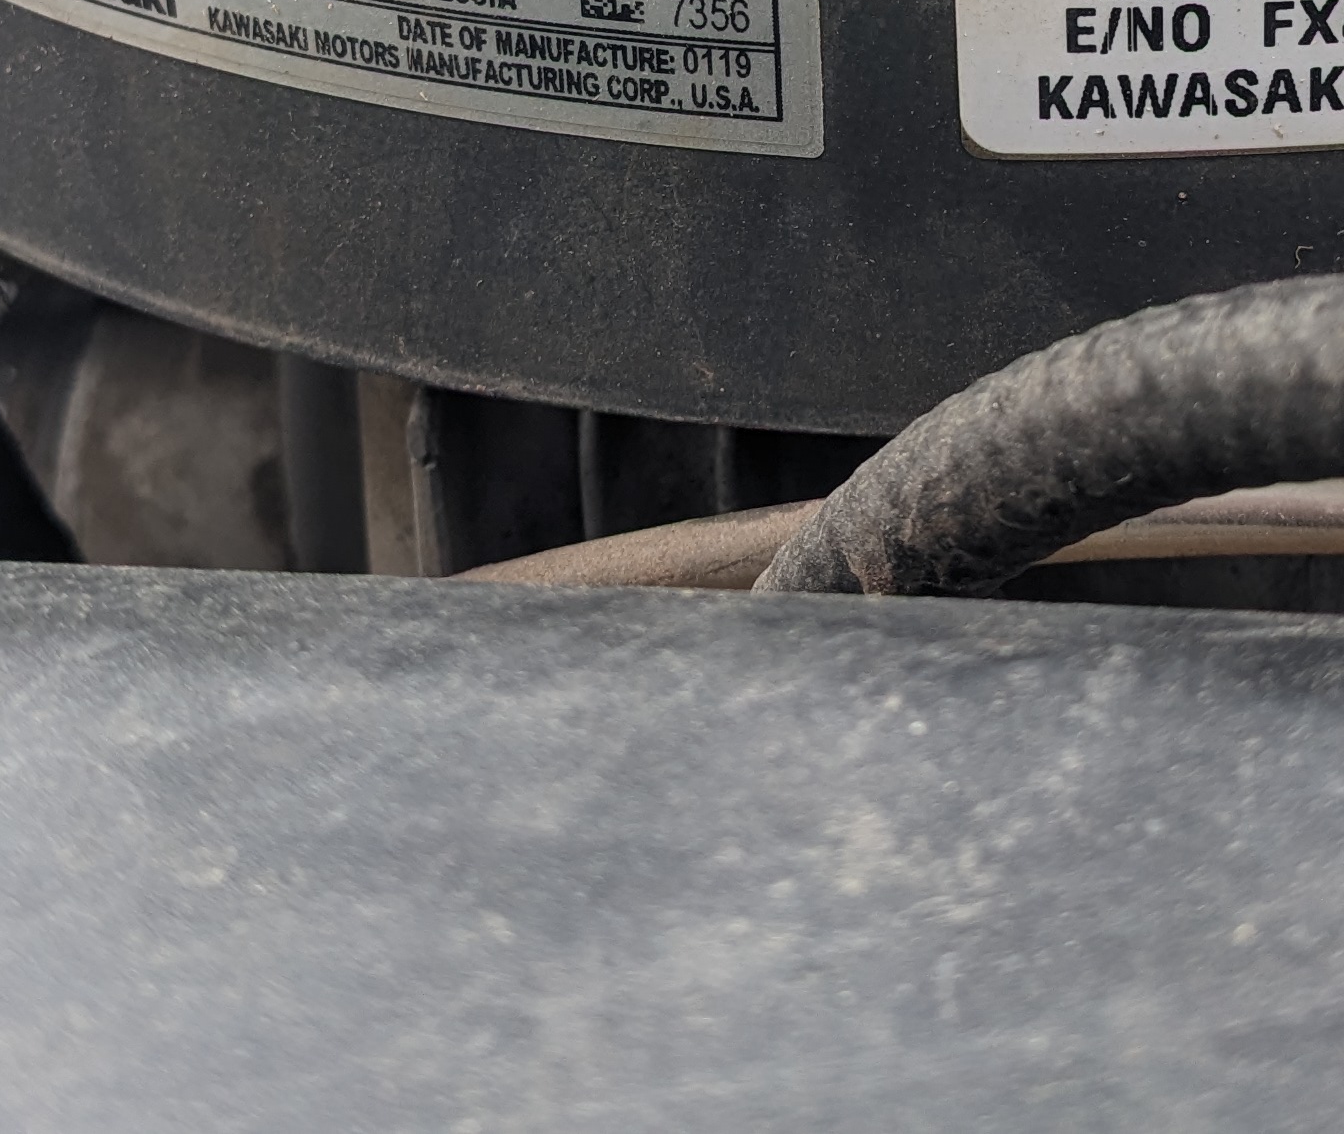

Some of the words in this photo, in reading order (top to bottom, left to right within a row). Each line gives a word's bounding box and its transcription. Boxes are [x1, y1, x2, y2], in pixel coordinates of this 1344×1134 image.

[207, 6, 309, 51] KAWASAKI
[314, 29, 400, 69] MOTORS
[407, 46, 601, 97] MANUFACTURING
[607, 74, 683, 109] CORP.,
[691, 82, 760, 113] U.S.A.
[397, 15, 454, 48] DATE
[459, 25, 487, 52] OF
[495, 29, 676, 75] MANUFACTURE:
[683, 45, 751, 79] 0119
[1066, 2, 1212, 55] E/NO
